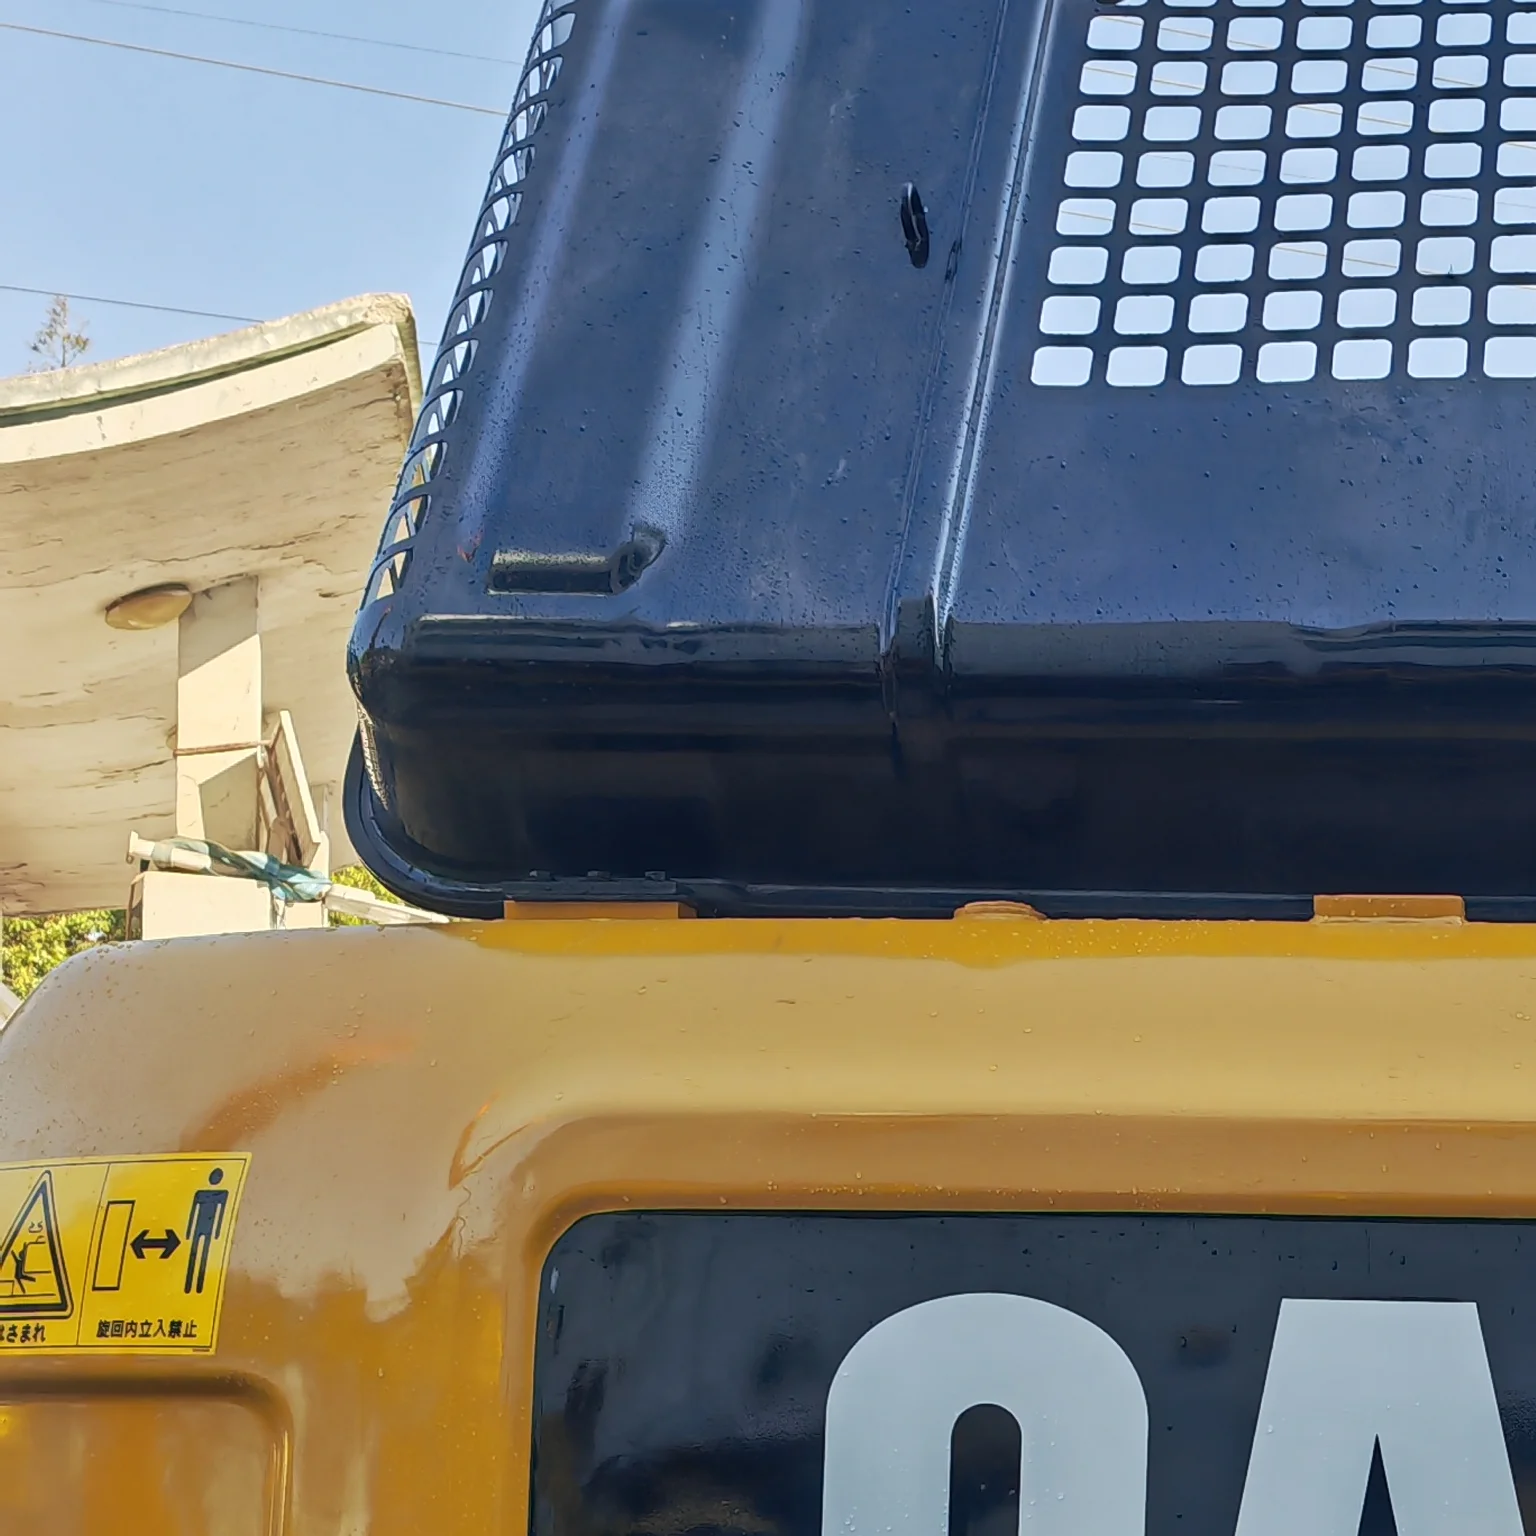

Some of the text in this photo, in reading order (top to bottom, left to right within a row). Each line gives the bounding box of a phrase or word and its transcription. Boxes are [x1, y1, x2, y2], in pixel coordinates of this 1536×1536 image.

[96, 1319, 198, 1338] 旋回内立入禁止
